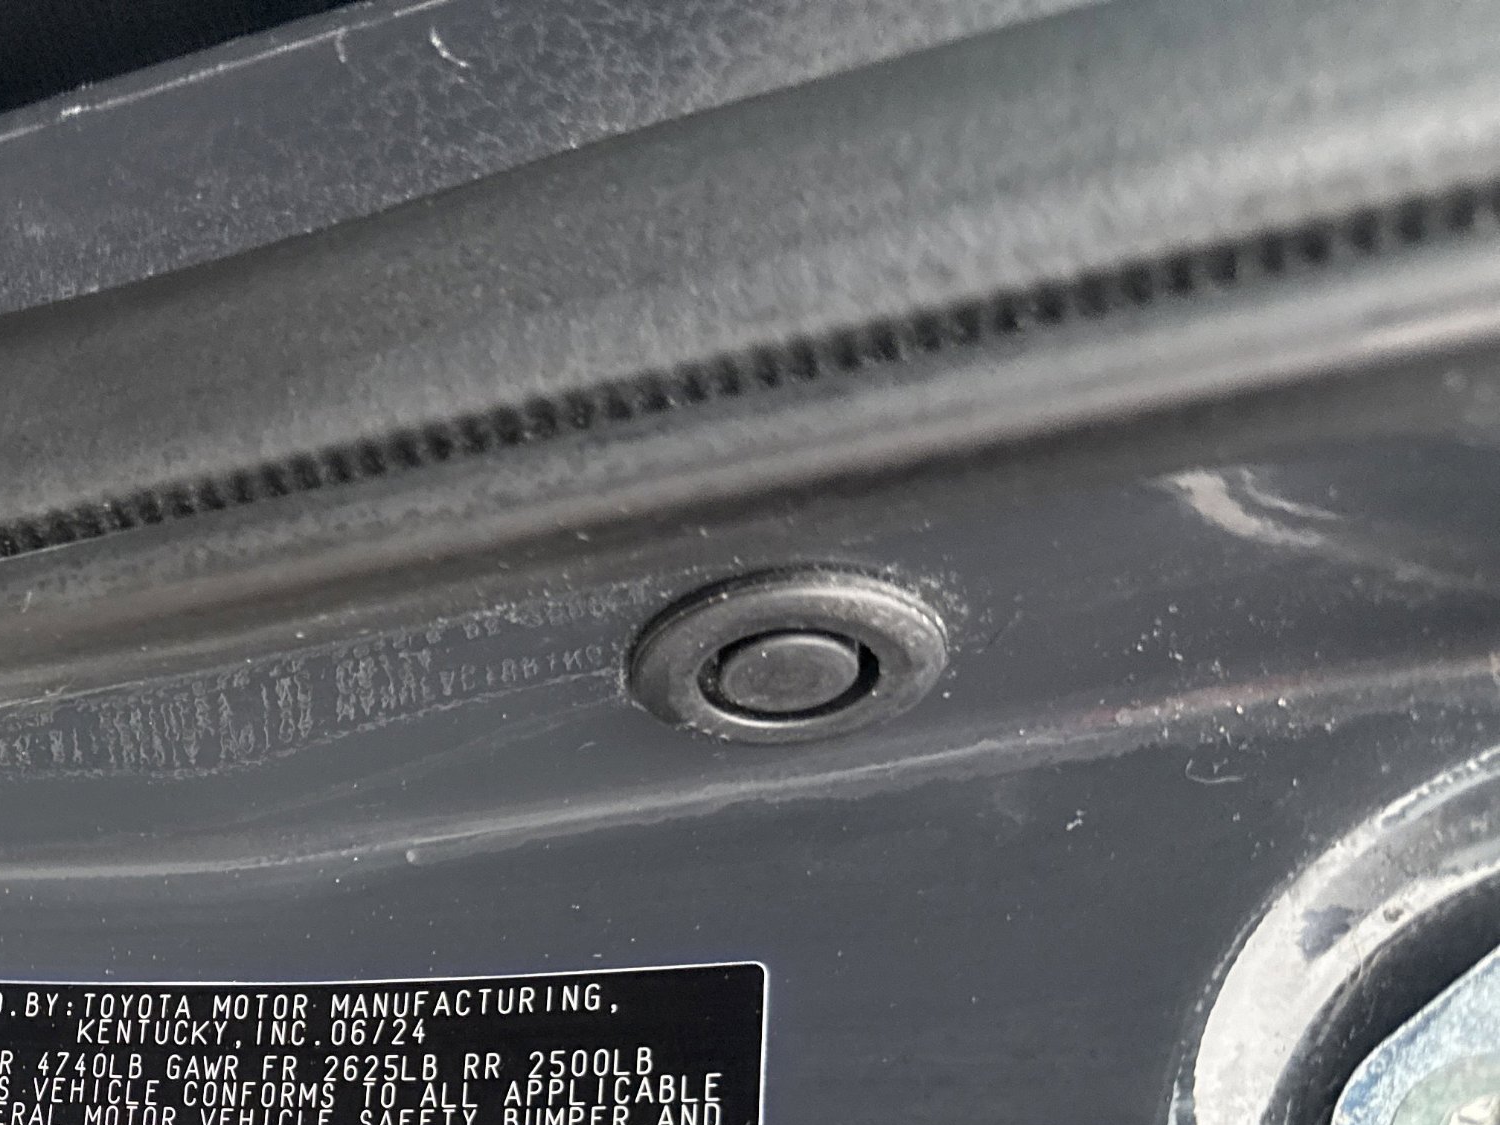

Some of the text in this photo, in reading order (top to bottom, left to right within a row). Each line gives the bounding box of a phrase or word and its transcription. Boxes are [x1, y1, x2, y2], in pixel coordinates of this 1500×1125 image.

[212, 993, 308, 1019] MOTOR
[330, 983, 617, 1019] MANUFACTURING,
[37, 1051, 142, 1079] 4740LB
[166, 1053, 239, 1080] GAWR
[261, 1054, 297, 1081] FR
[323, 1054, 437, 1082] 2625LB
[463, 1053, 501, 1080] RR
[528, 1046, 653, 1079] 2500LB
[33, 1076, 160, 1105] VEHICLE
[183, 1081, 334, 1108] CONFORMS
[362, 1082, 396, 1109] TO
[419, 1081, 478, 1109] ALL
[503, 1071, 721, 1109] APPLICABLE
